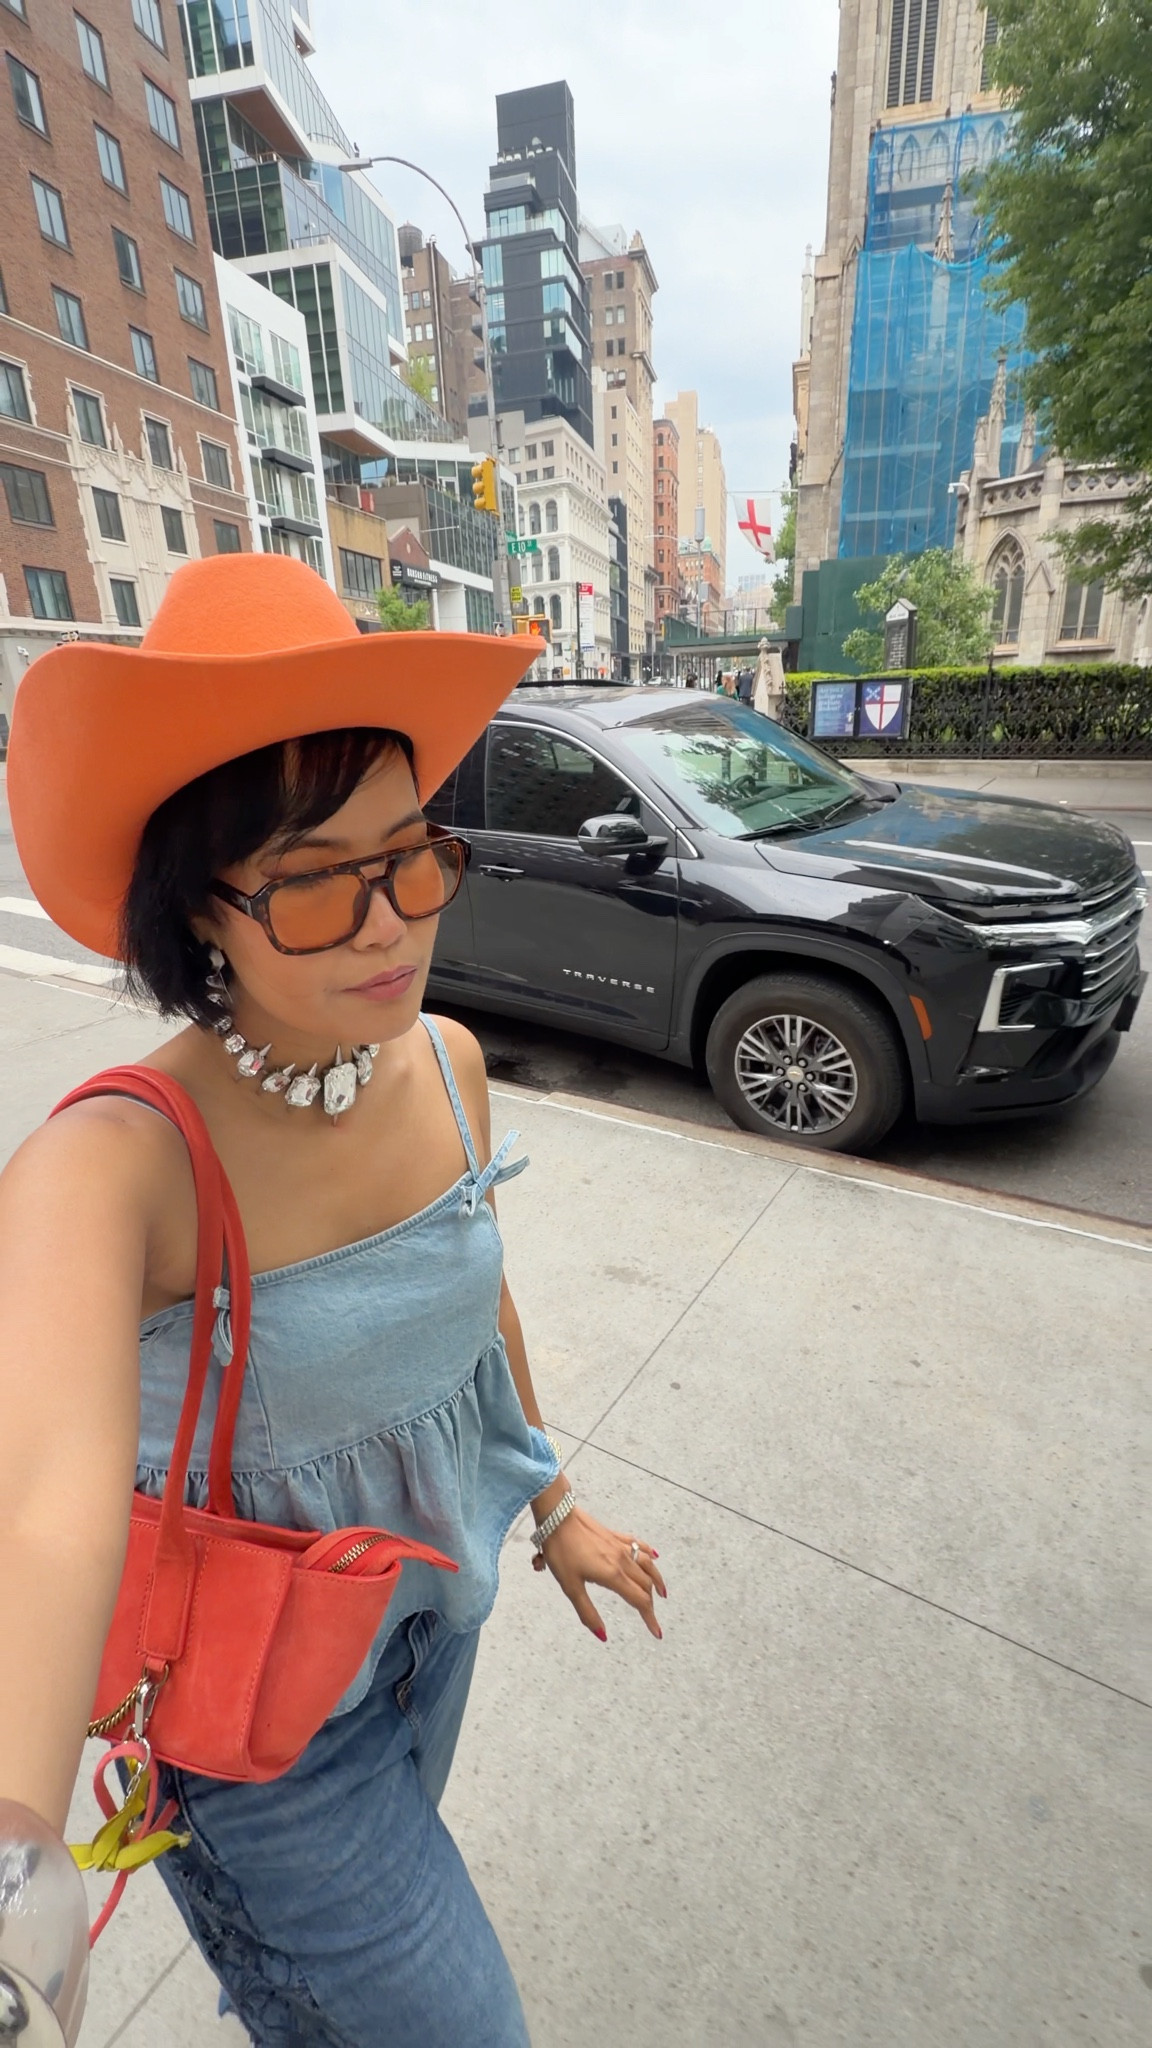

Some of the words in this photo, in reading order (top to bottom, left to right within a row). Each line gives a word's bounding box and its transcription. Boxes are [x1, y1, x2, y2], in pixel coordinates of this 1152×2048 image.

[511, 542, 517, 553] E
[518, 541, 526, 552] 10
[562, 968, 655, 994] TRAVERSE
